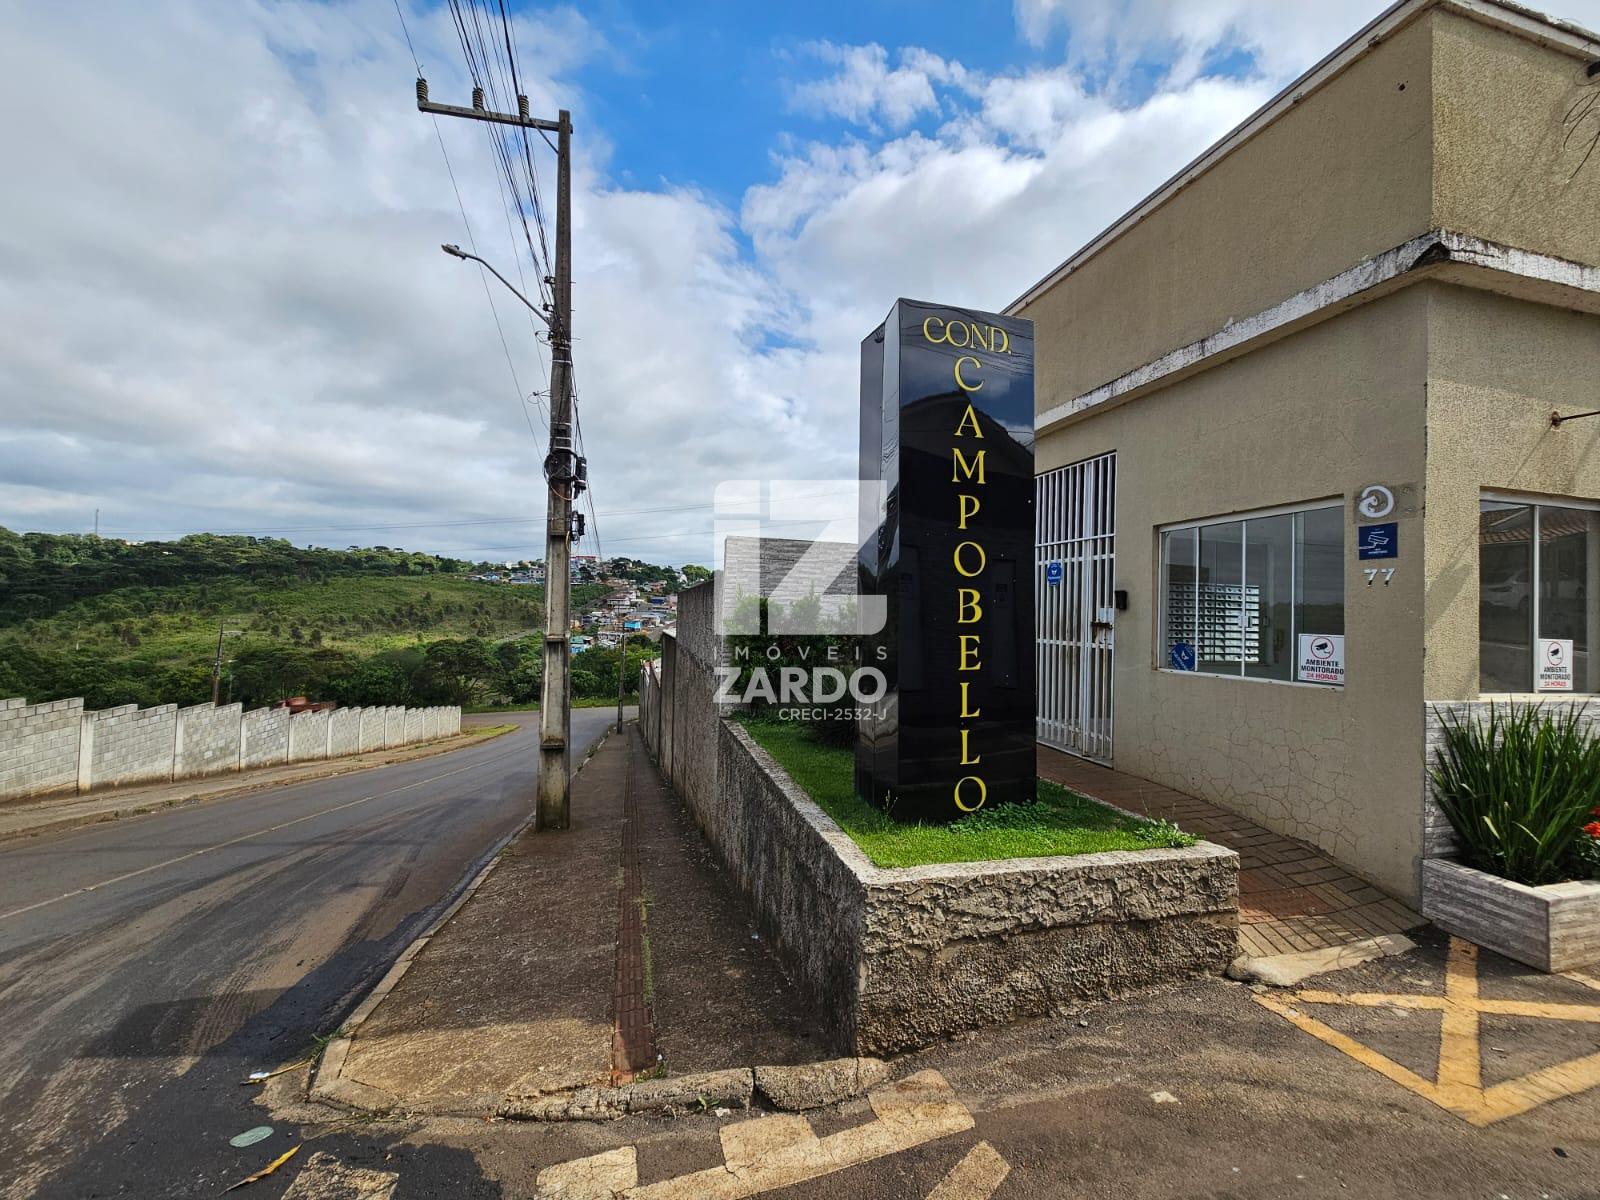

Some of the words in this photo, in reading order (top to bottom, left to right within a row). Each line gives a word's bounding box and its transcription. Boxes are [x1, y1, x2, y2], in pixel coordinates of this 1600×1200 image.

[923, 316, 1012, 355] COND.
[1364, 568, 1395, 587] 77
[1301, 665, 1344, 675] MONITORADO
[1305, 658, 1340, 668] AMBIENTE
